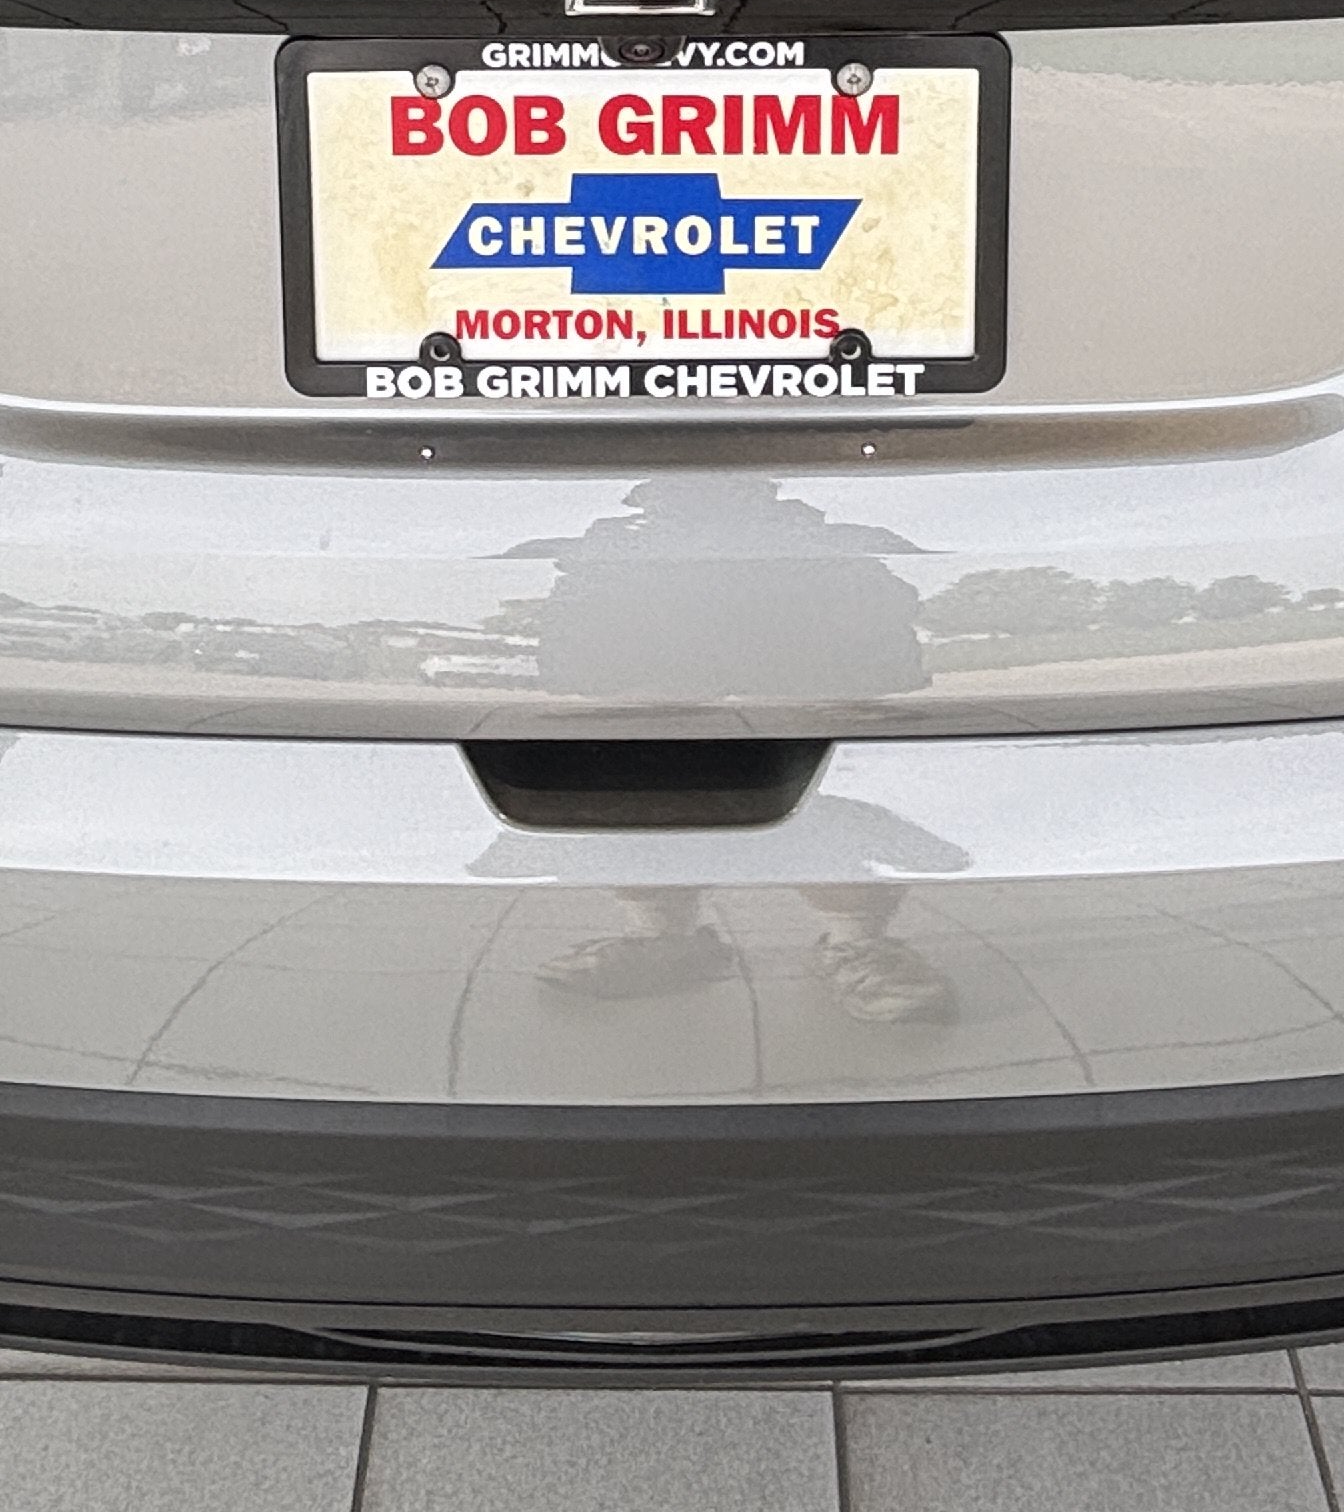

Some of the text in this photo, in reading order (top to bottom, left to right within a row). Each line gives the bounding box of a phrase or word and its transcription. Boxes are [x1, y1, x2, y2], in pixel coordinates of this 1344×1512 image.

[481, 41, 805, 68] GRIMMVY.COM
[390, 93, 900, 157] BOB GRIMM
[467, 214, 821, 256] CHEVROLET
[454, 308, 840, 345] MORTON, ILLINOIS
[366, 363, 925, 399] BOB GRIMM CHEVROLET
